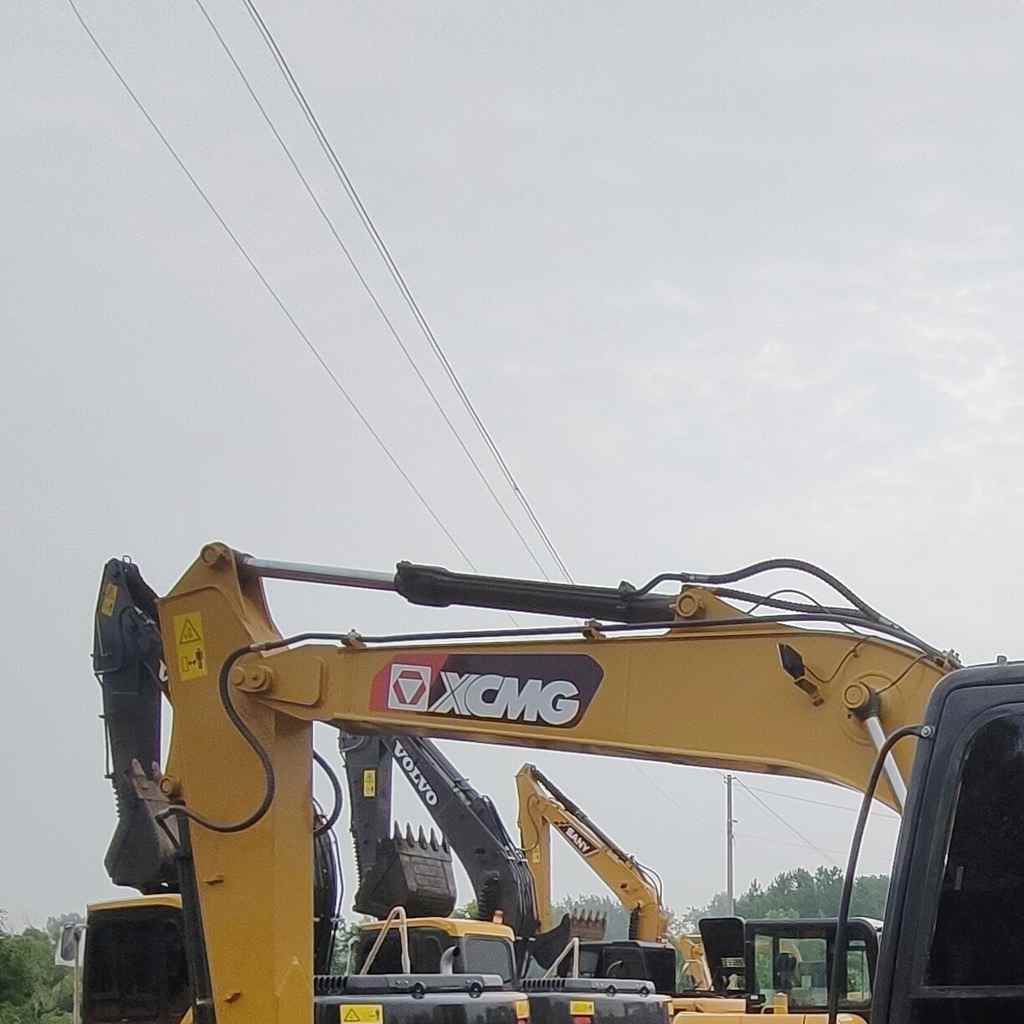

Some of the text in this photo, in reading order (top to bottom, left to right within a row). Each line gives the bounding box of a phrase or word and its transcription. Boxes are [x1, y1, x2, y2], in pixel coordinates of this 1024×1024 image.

[428, 671, 581, 726] XCMG
[394, 739, 438, 806] VOLVO
[565, 826, 591, 853] SANY
